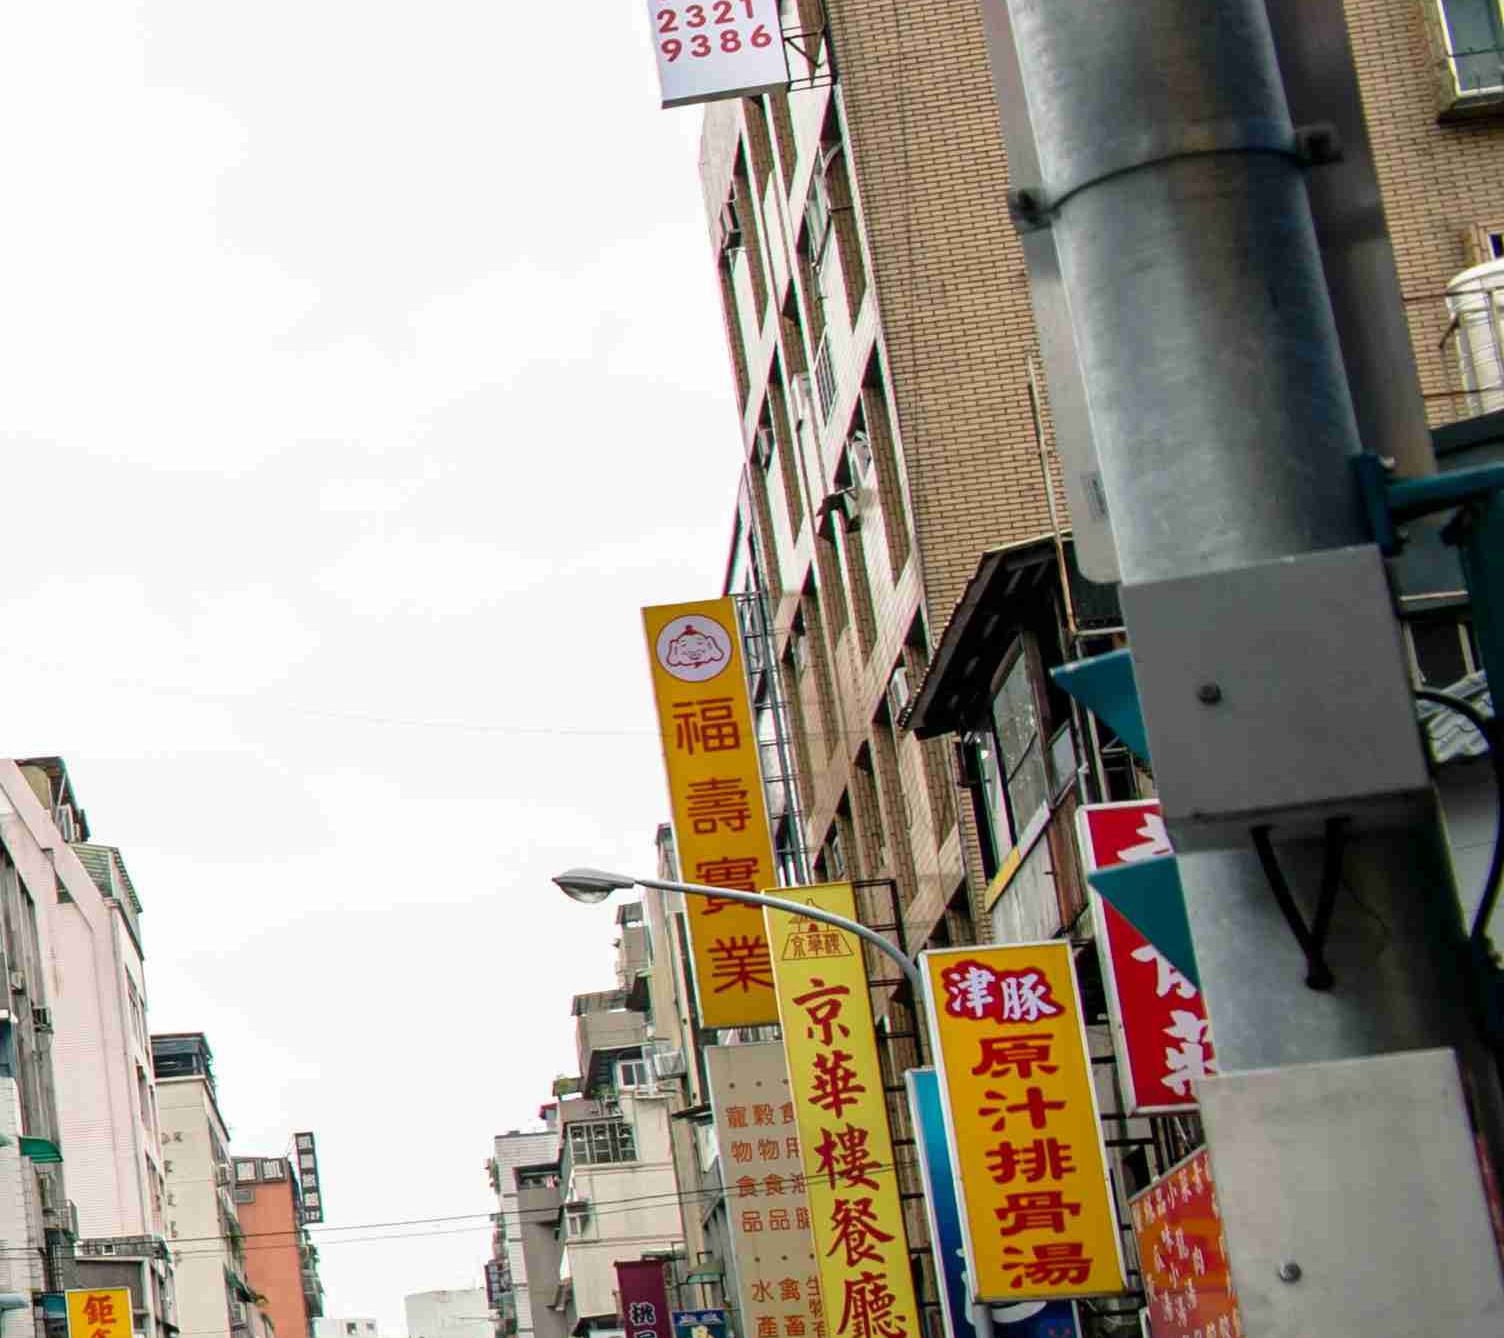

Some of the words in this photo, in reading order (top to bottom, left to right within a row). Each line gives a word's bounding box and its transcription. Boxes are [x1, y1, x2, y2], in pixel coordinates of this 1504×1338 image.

[661, 25, 772, 62] 9386
[672, 696, 775, 994] 福壽實業
[791, 933, 842, 957] 京華樓
[947, 967, 1061, 1023] 津豚
[726, 1105, 764, 1234] 寵物食品
[970, 1032, 1093, 1291] 原汁排骨湯
